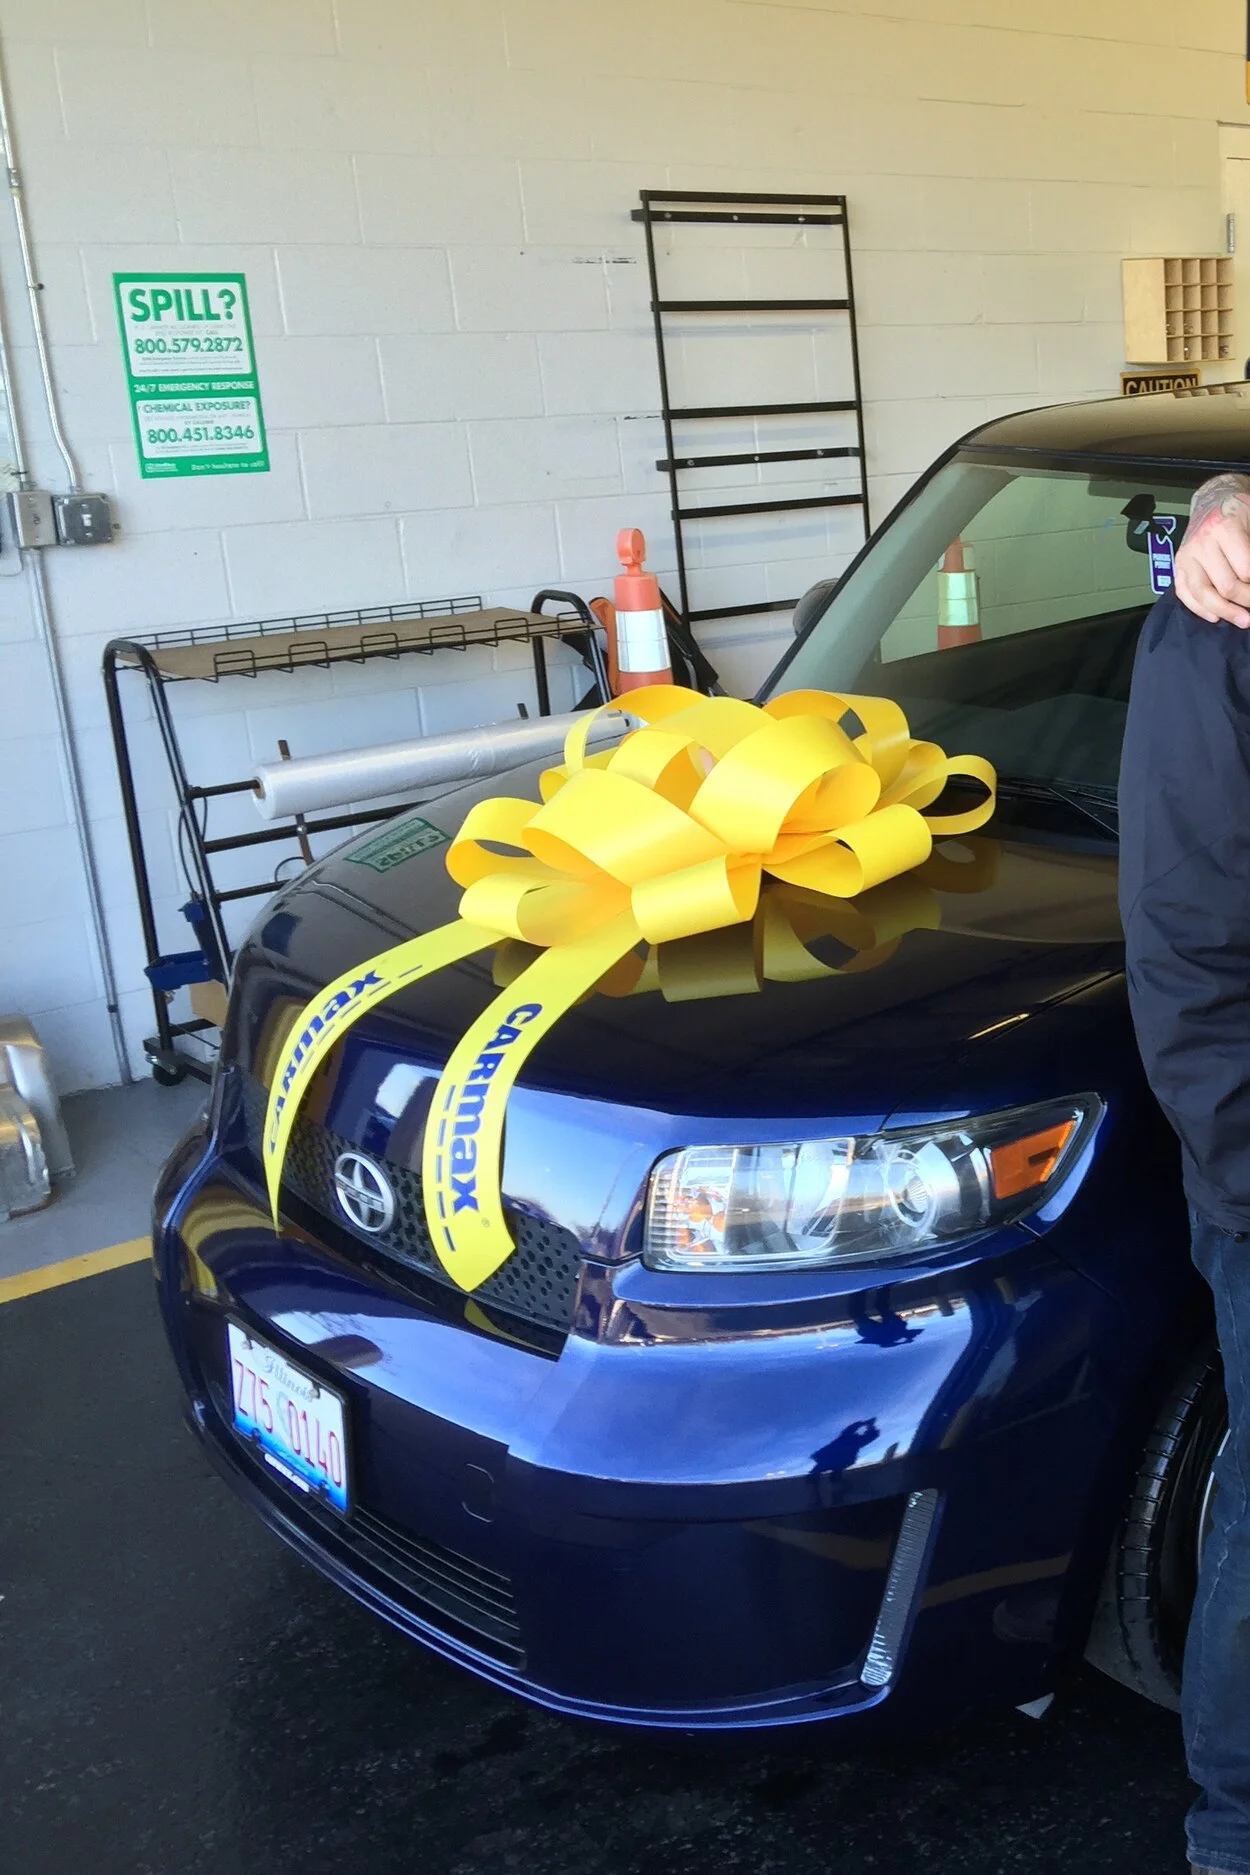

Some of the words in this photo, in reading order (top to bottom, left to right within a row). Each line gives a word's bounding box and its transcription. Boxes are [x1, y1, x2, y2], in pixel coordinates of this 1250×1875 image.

[129, 288, 237, 323] SPILL?
[134, 337, 244, 355] 800.579.2872
[158, 382, 210, 393] EMERGENCY
[211, 381, 255, 391] RESPONSE
[143, 401, 194, 414] CHEMICAL
[195, 400, 252, 412] EXPOSURE?
[147, 425, 255, 444] 800.451.8346
